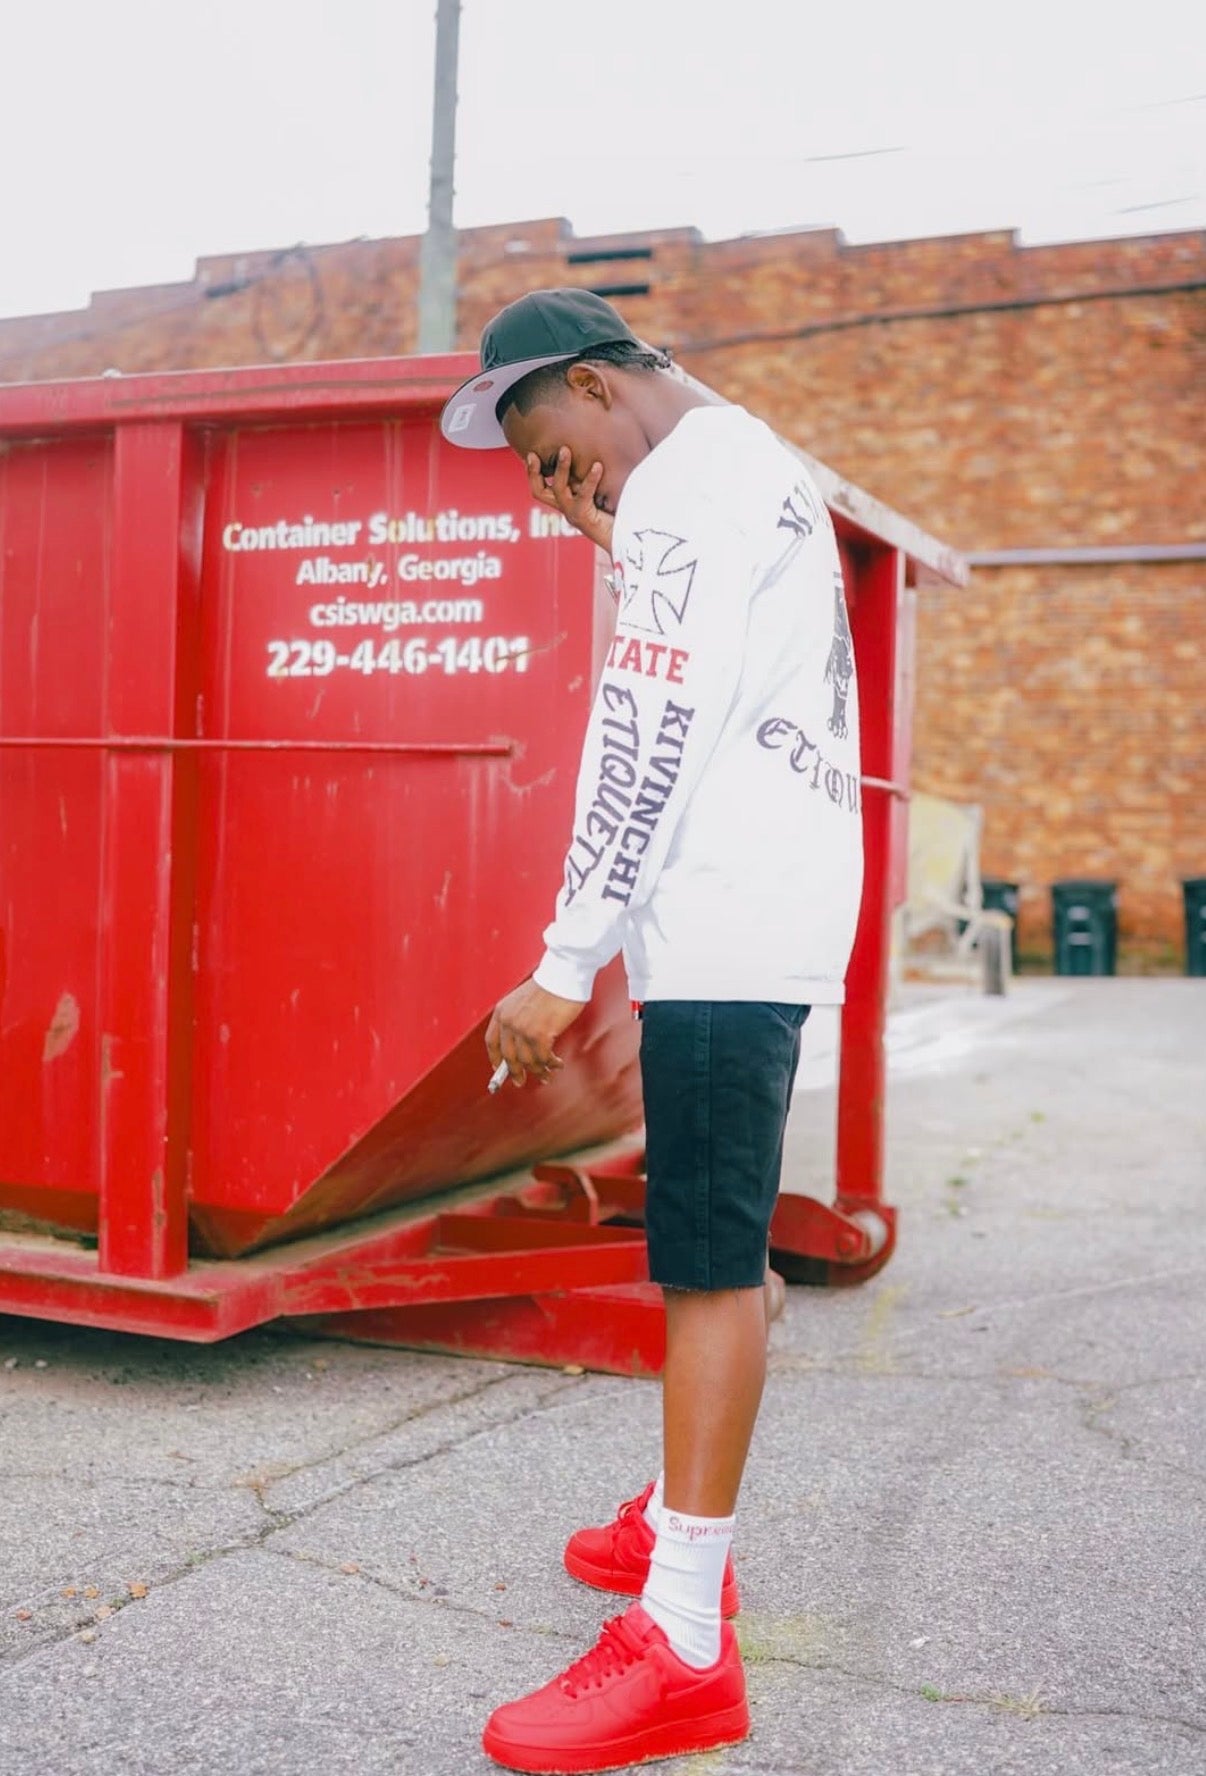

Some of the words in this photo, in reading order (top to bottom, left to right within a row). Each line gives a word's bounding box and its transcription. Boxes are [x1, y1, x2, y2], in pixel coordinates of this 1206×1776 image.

[222, 514, 362, 552] Container
[368, 508, 521, 544] Solutions,
[295, 556, 389, 588] Albany,
[397, 552, 501, 587] Georgia
[309, 597, 483, 631] csiswga.com
[265, 636, 530, 677] 229-446-1401
[601, 699, 695, 907] KIVINCHI
